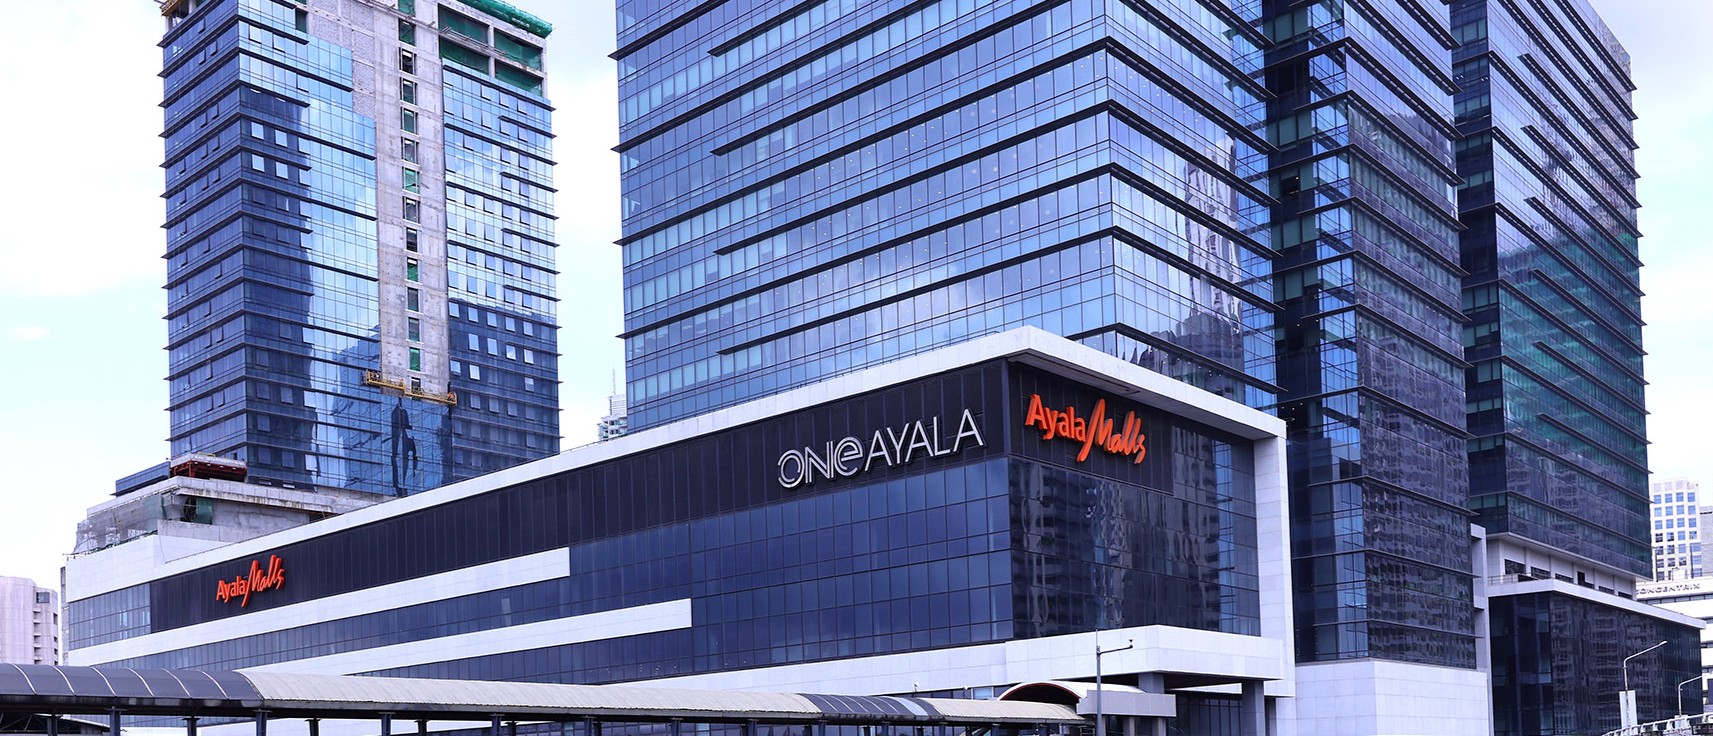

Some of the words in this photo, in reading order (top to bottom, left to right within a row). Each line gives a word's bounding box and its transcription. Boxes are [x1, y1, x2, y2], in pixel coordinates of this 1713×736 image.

[865, 408, 984, 472] AYALA
[1025, 394, 1086, 442] Ayala
[1077, 398, 1146, 464] Malls
[216, 575, 247, 603] Ayala
[241, 554, 285, 607] Malls
